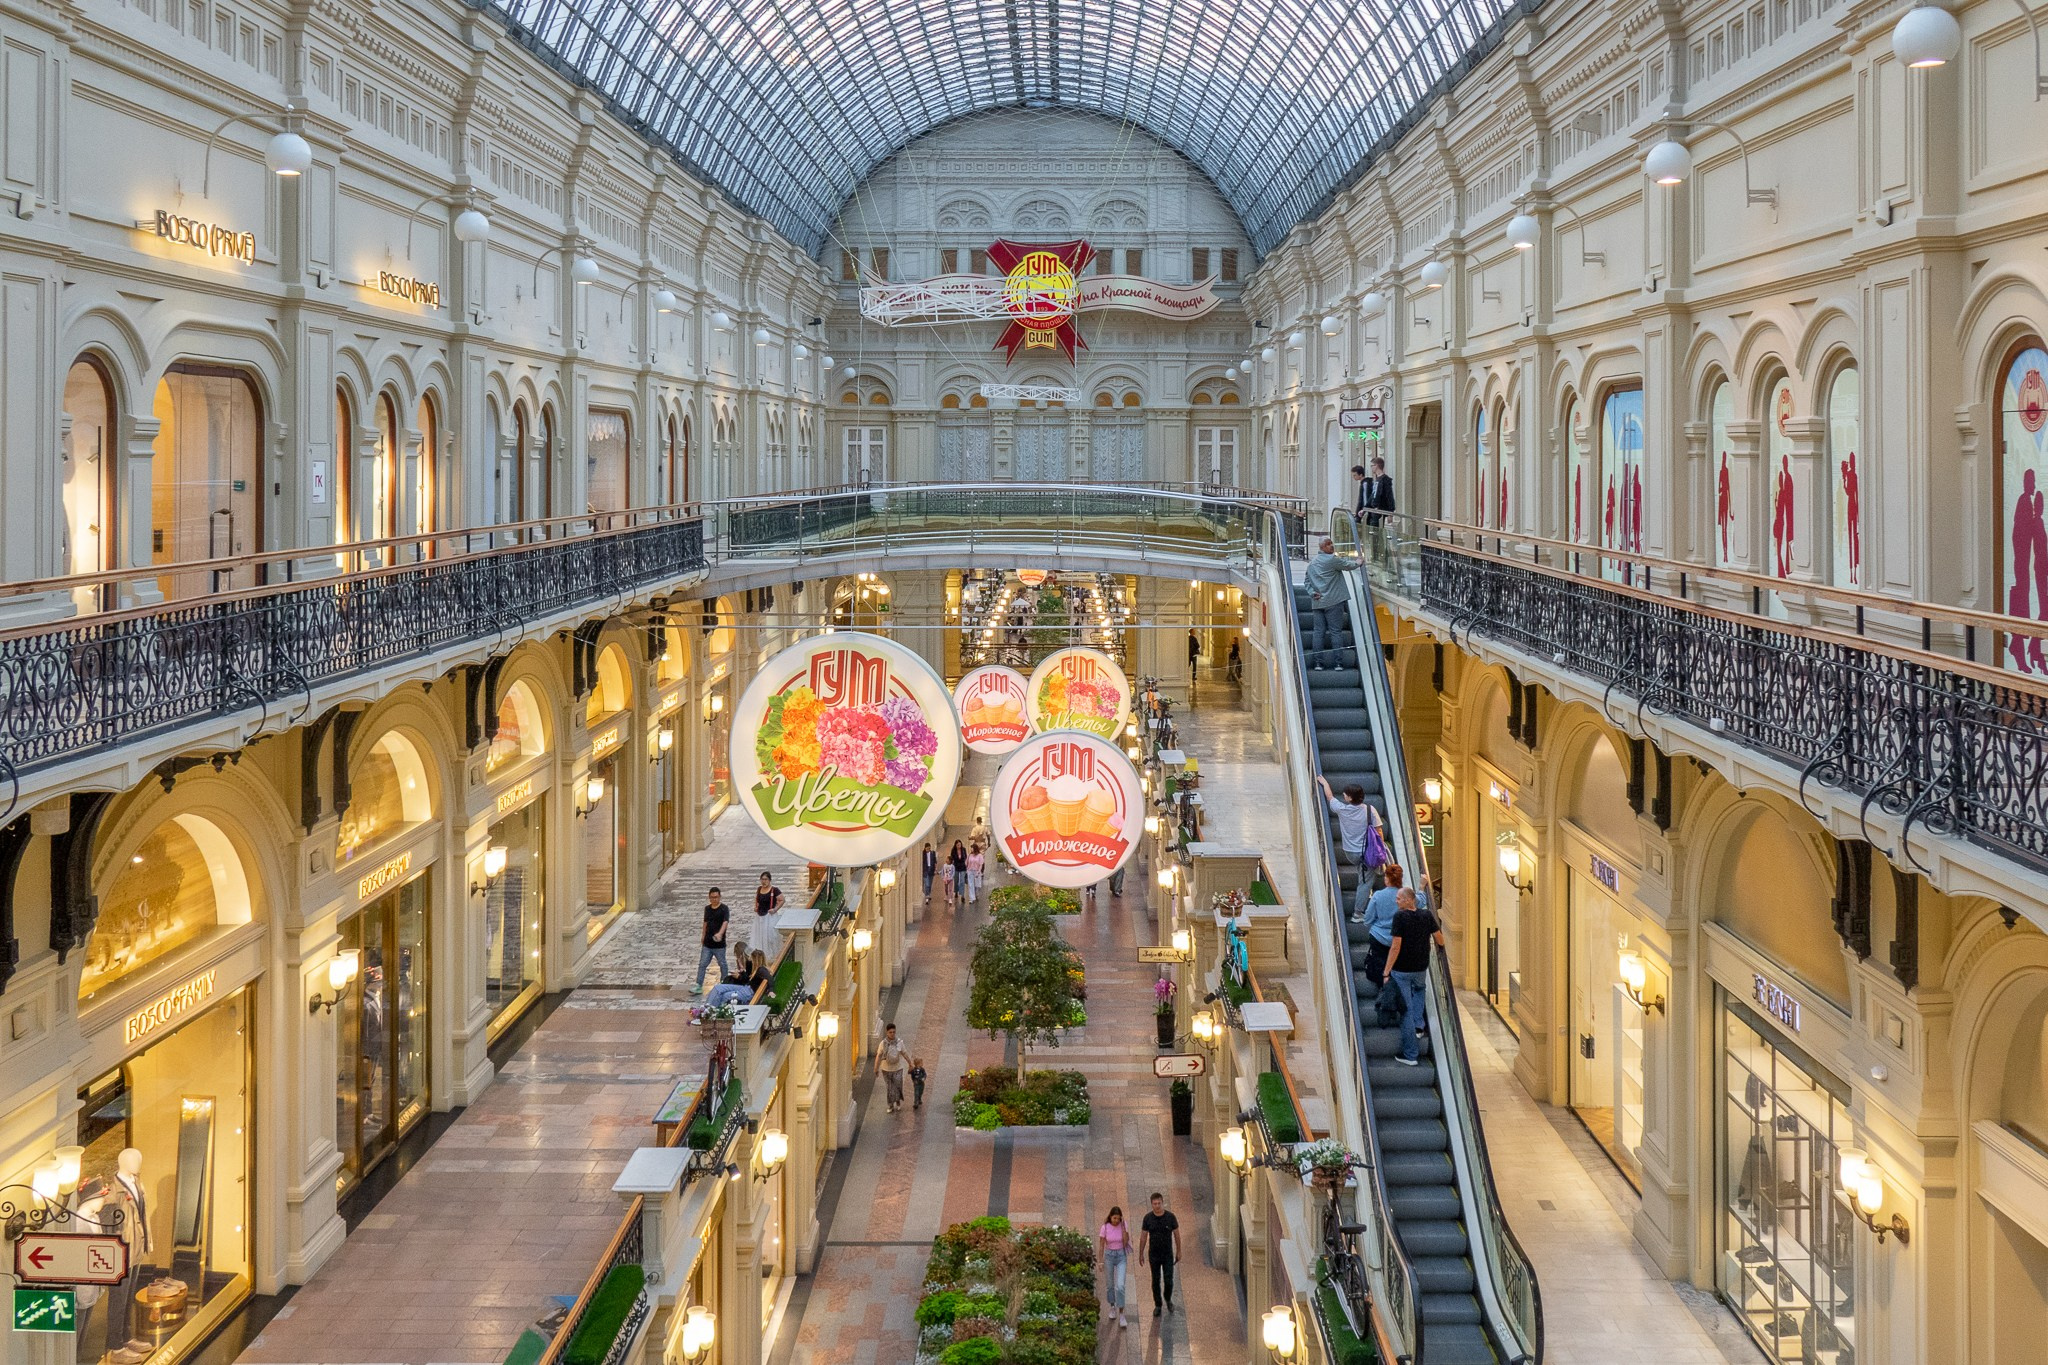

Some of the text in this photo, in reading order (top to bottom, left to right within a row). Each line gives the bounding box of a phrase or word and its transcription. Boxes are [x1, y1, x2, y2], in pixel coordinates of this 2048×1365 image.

[154, 209, 209, 250] BOSCO
[1026, 254, 1058, 279] ГУМ
[378, 270, 411, 299] BOSCO
[1083, 285, 1206, 311] на Красной площади
[1028, 331, 1053, 343] GUM
[810, 649, 888, 707] ГУМ
[1060, 655, 1097, 682] ГУМ
[978, 672, 1010, 695] ГУМ
[966, 726, 1023, 739] Мороженое
[1044, 709, 1111, 733] Цветы
[1042, 742, 1096, 783] ГУМ
[771, 763, 913, 827] Цветы
[1017, 837, 1118, 861] Мороженое
[125, 969, 217, 1044] BOSCO FAMILY
